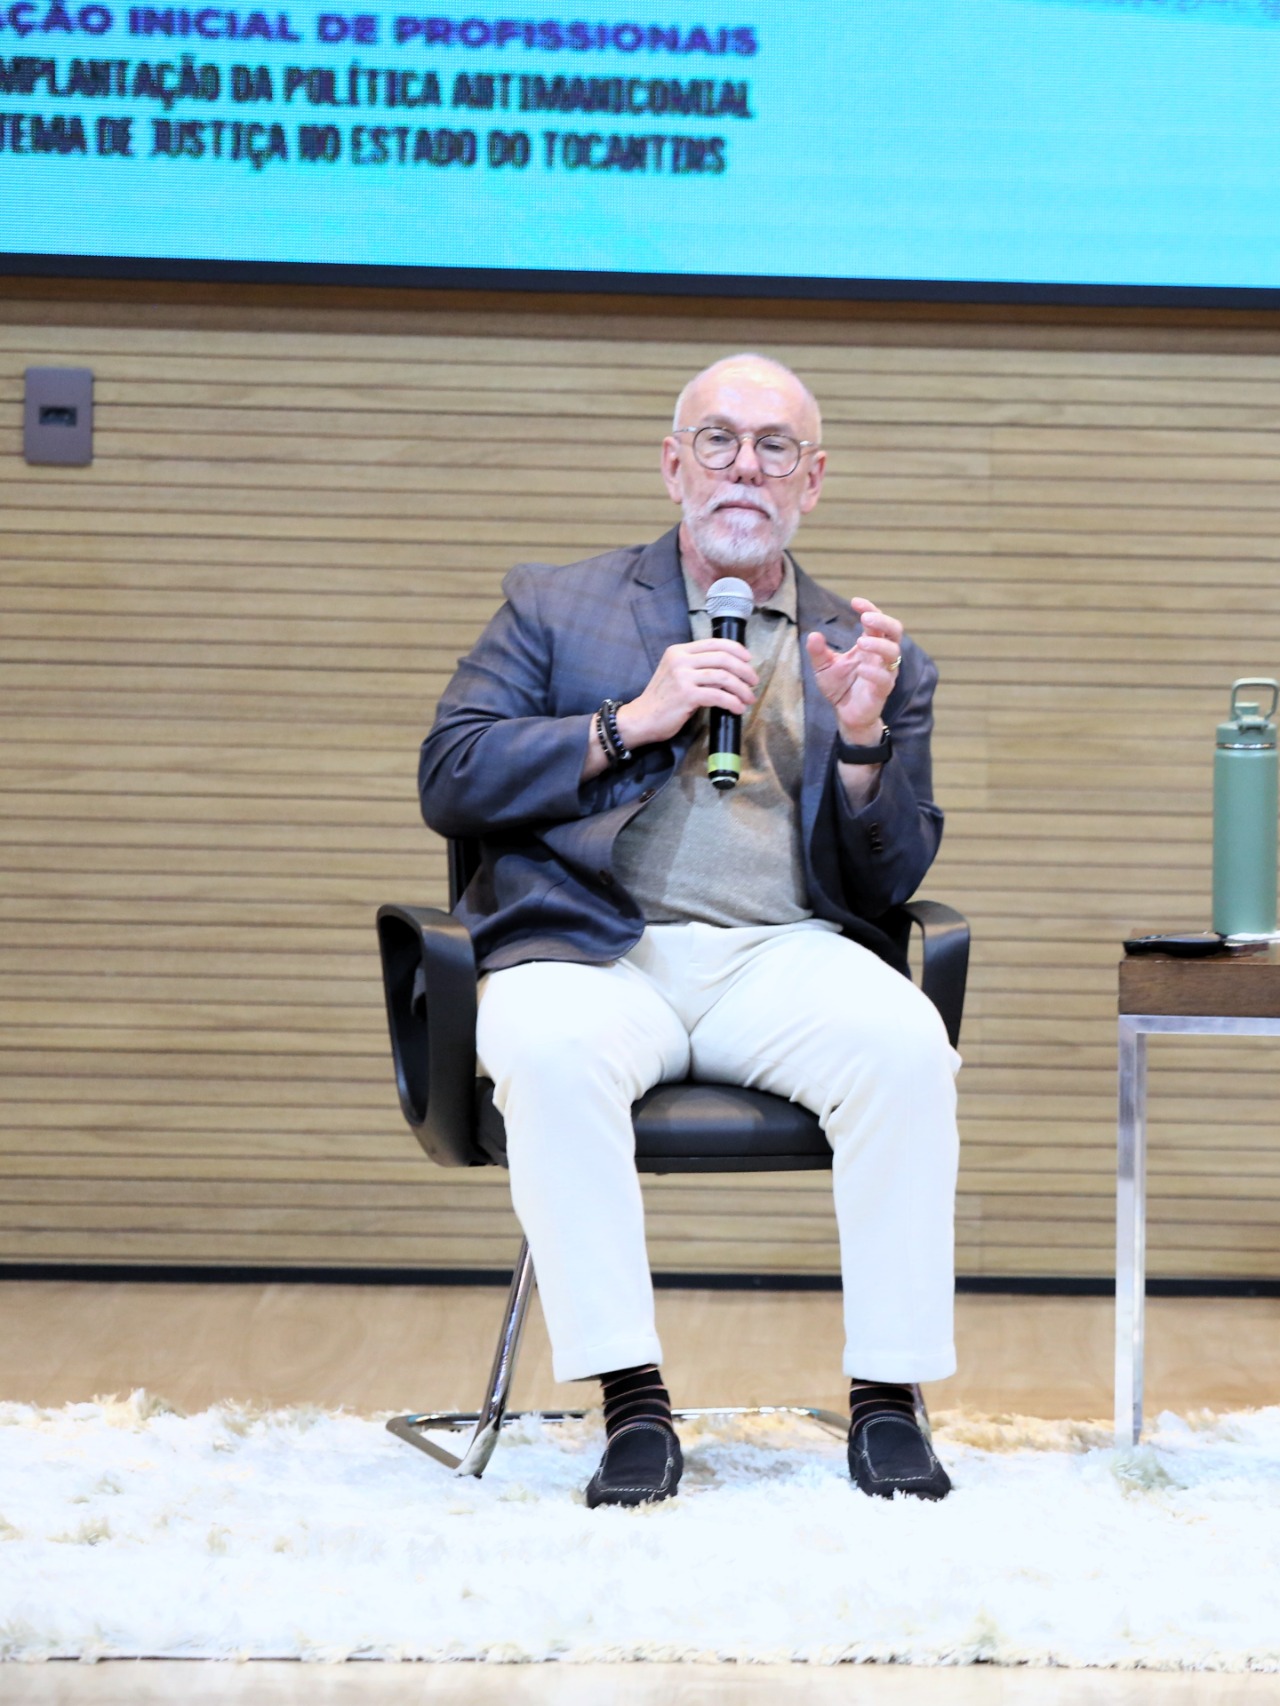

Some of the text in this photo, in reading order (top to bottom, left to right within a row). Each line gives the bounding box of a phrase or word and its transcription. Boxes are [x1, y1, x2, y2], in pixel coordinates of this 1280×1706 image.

[0, 0, 757, 55] ÇÃO INICIAL DE PROFISSIONAIS
[231, 64, 274, 103] DA
[284, 59, 441, 108] POLÍTICA
[452, 73, 750, 118] ANTIMANICOMIAL
[96, 116, 133, 157] DE
[152, 118, 288, 170] JUSTIÇA
[298, 124, 341, 162] NO
[351, 125, 477, 167] ESTADO
[488, 130, 531, 168] DO
[544, 131, 725, 173] TOCANTINS
